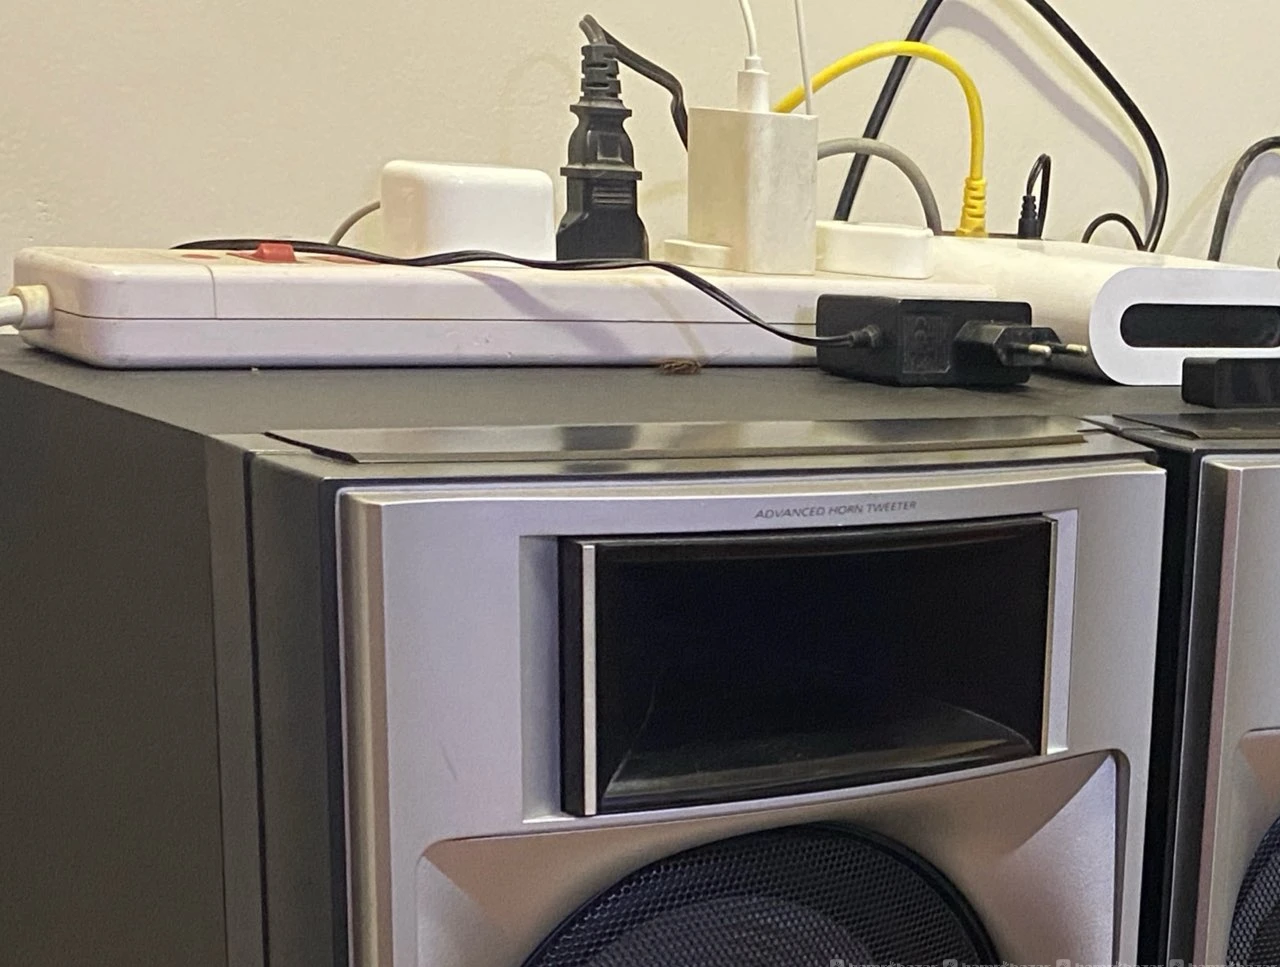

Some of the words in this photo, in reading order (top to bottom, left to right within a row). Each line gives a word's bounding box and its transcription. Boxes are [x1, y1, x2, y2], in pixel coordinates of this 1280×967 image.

[754, 504, 825, 519] ADVANCED
[828, 503, 863, 515] HORN
[866, 500, 917, 513] TWEETER
